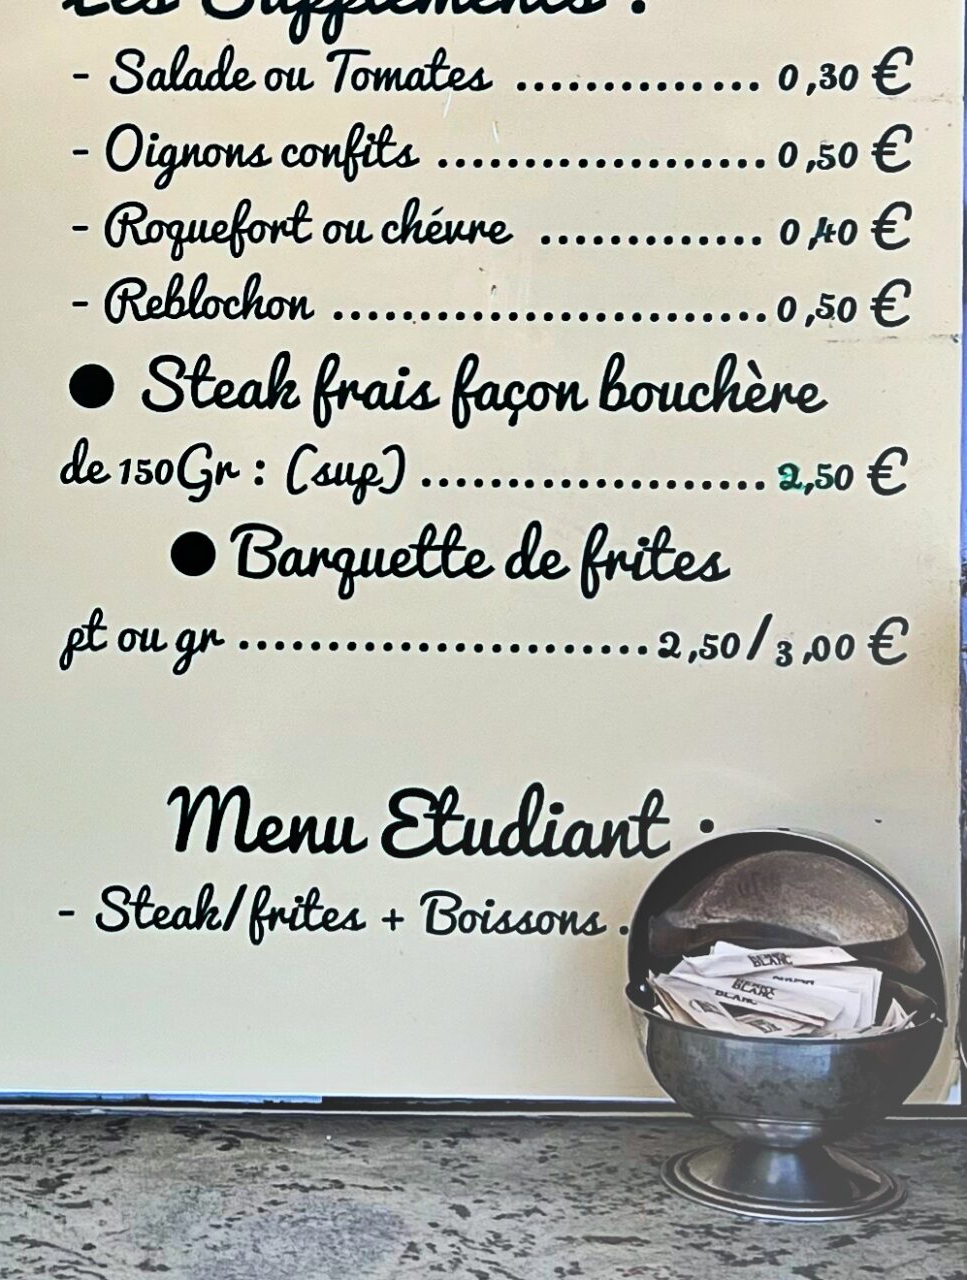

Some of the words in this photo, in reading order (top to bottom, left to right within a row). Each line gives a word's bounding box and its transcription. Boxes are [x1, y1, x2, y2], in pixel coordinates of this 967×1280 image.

[109, 43, 257, 95] Salade
[264, 67, 315, 92] ou
[325, 46, 494, 94] Tomates
[778, 62, 859, 97] 0,30
[105, 122, 273, 191] Oignons
[280, 121, 421, 183] confits
[778, 141, 859, 174] 0,50
[104, 198, 313, 262] Roquefort
[322, 219, 374, 245] ou
[381, 196, 515, 245] chévre
[779, 216, 858, 251] 0,40
[104, 272, 315, 325] Reblochon
[777, 292, 858, 328] 0,50
[141, 350, 302, 413] Steak
[312, 352, 441, 429] frais
[451, 352, 589, 430] façon
[598, 351, 829, 414] bouchère
[59, 436, 112, 485] de
[286, 442, 406, 506] (sup)
[777, 462, 854, 496] 2,50
[229, 522, 496, 601] Barquette
[504, 519, 571, 581] de
[580, 522, 731, 600] frites
[58, 607, 108, 671] pt
[117, 627, 169, 653] ou
[172, 628, 226, 676] gr
[166, 784, 369, 855] Menu
[380, 781, 671, 859] Etudiant
[419, 889, 607, 937] Boissons
